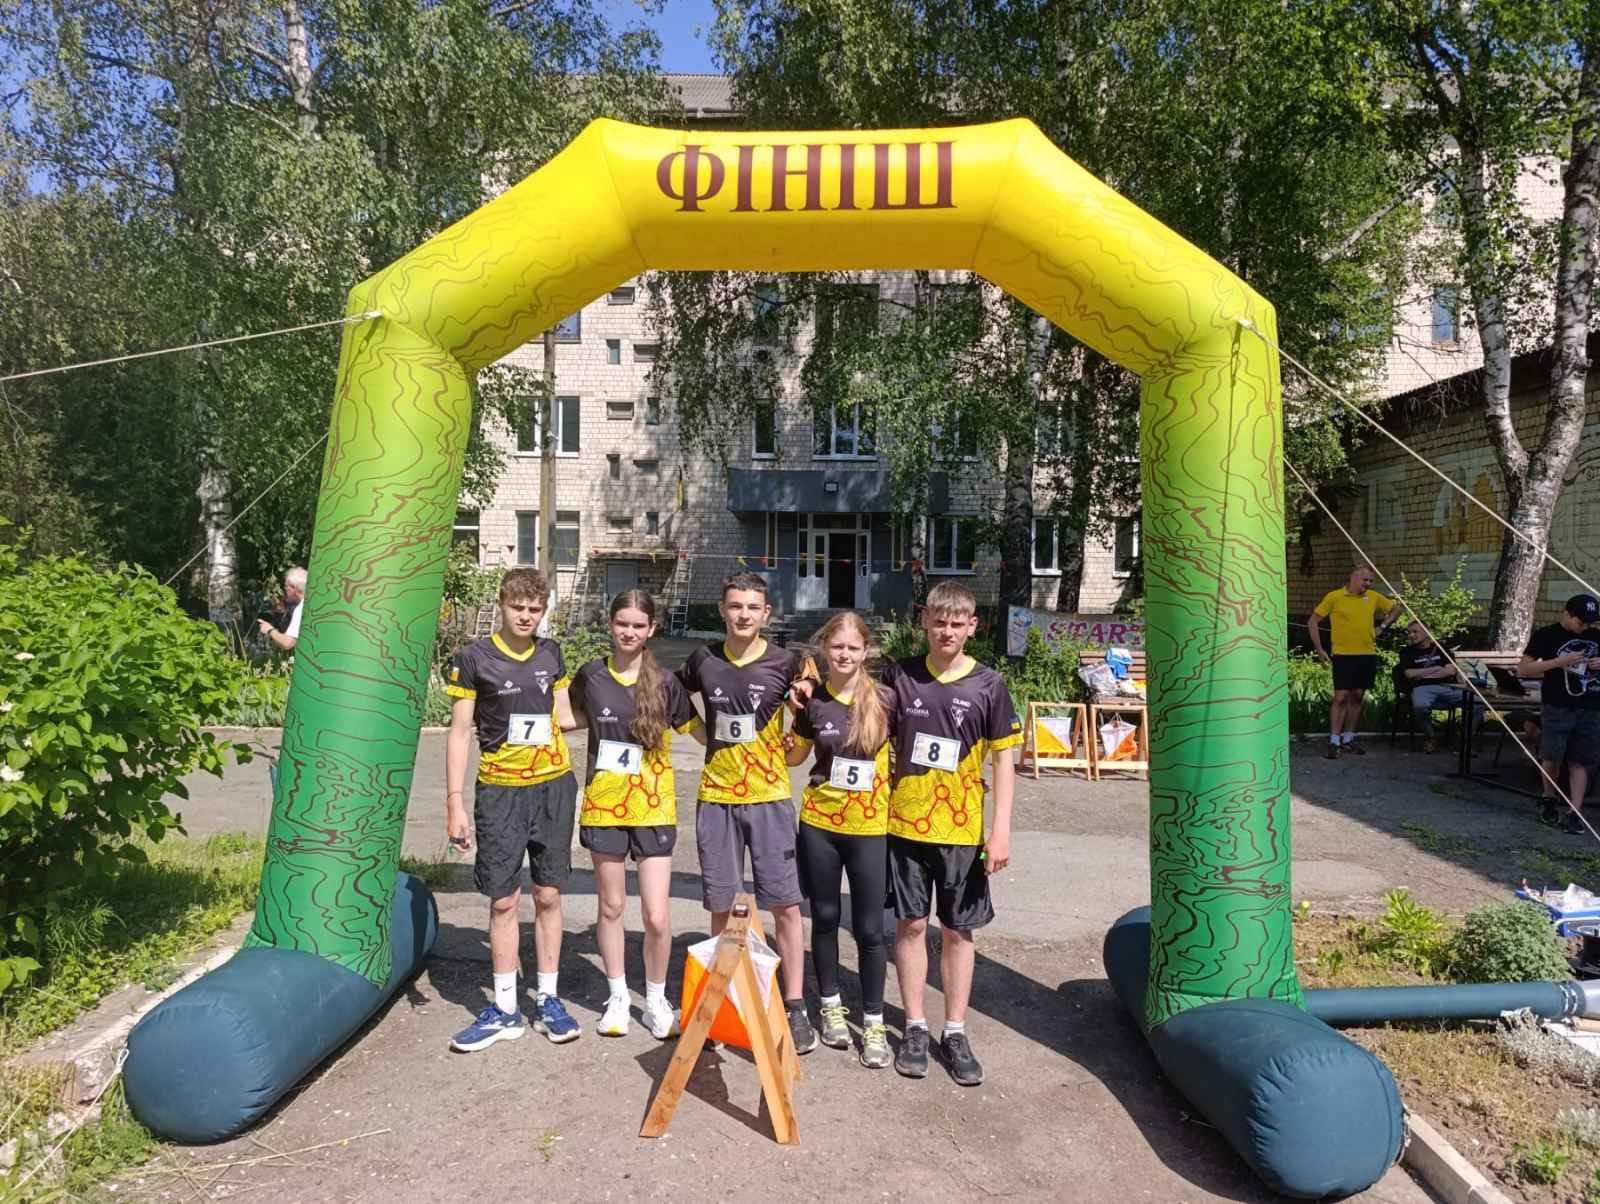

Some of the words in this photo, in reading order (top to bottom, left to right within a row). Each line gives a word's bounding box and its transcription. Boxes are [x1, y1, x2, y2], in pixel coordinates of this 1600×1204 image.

[656, 141, 958, 213] ФІНІШ
[523, 720, 536, 740] 7
[729, 720, 742, 738] 6
[617, 748, 630, 767] 4
[927, 741, 941, 762] 8
[846, 765, 860, 786] 5
